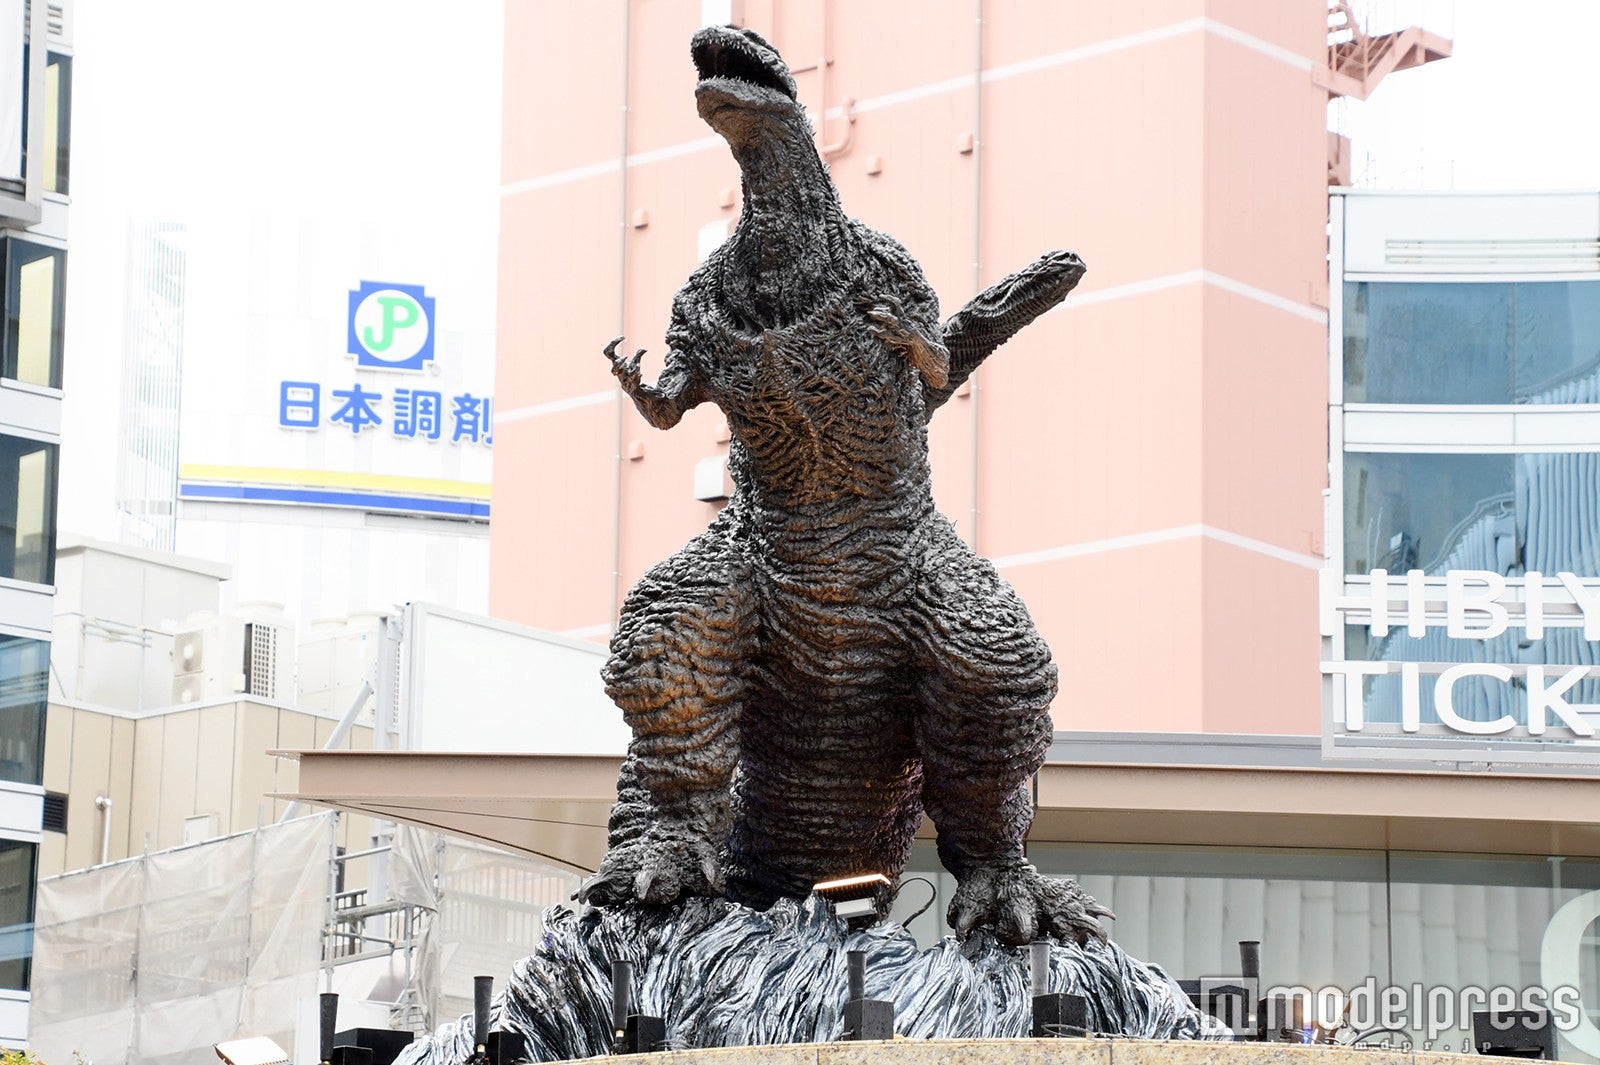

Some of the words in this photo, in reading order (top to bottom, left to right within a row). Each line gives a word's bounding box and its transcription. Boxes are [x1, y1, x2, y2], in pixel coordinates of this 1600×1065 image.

[364, 296, 419, 352] JP
[279, 380, 493, 445] 日本調剤
[1319, 661, 1596, 736] TICK
